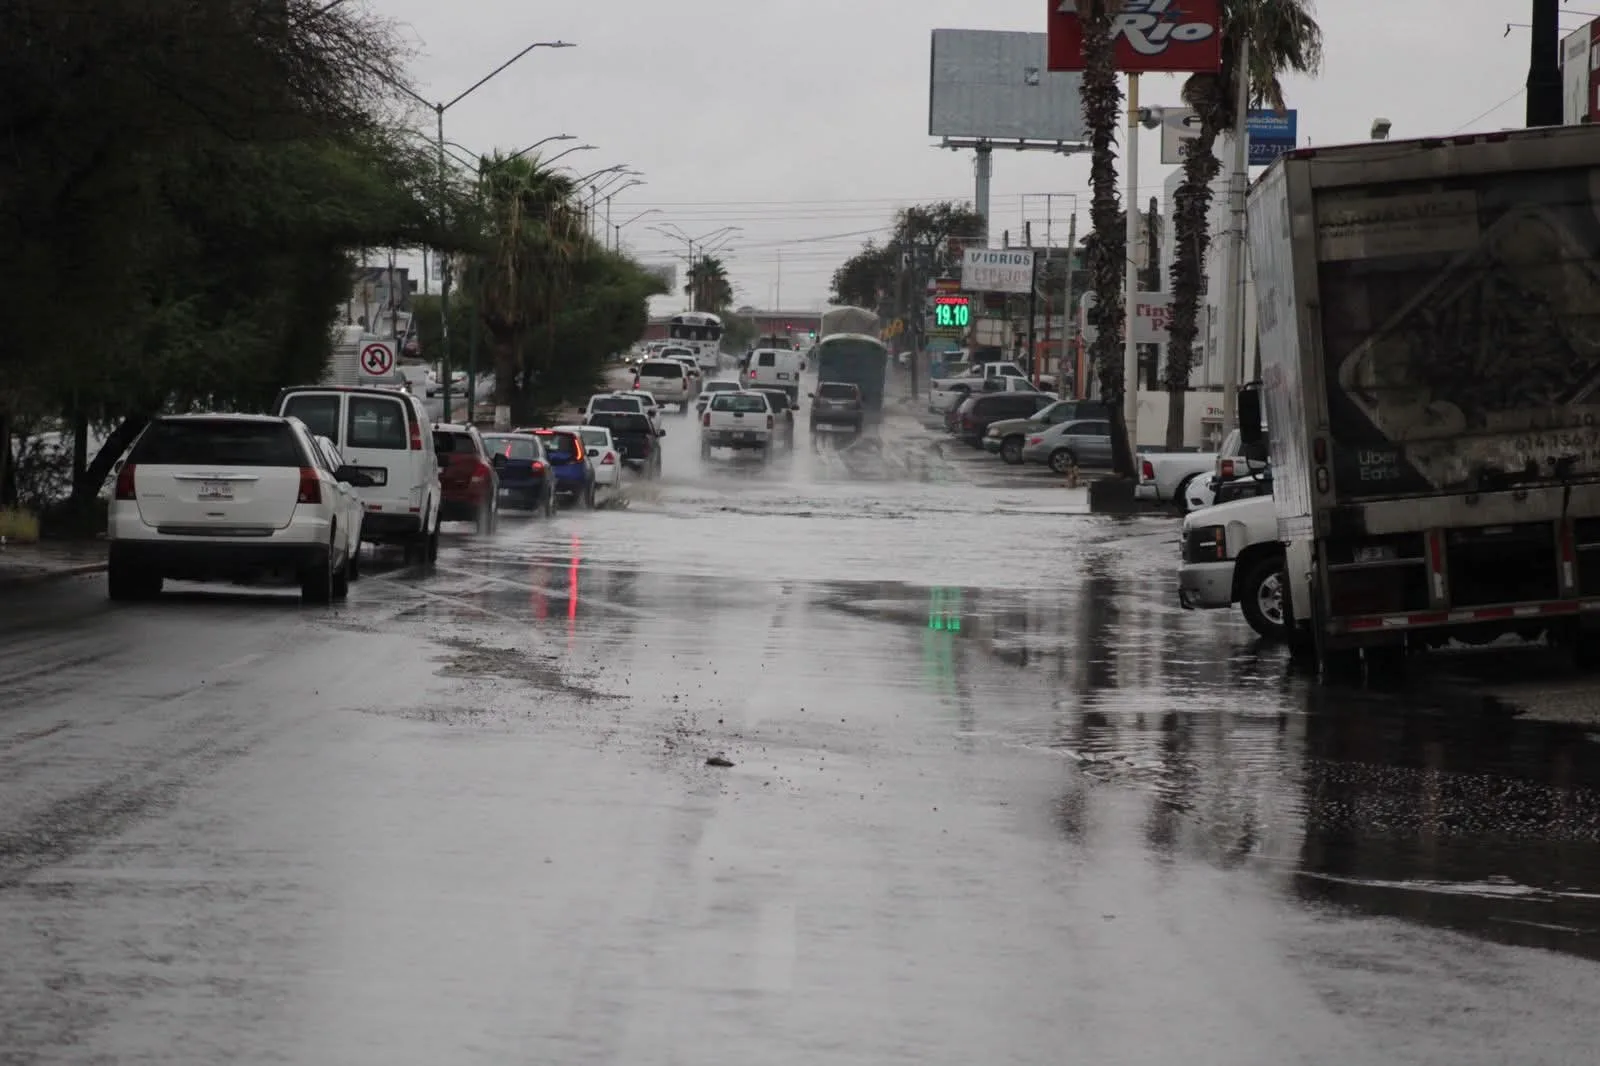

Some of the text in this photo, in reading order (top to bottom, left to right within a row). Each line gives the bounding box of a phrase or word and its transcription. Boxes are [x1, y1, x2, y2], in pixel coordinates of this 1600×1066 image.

[971, 252, 1030, 266] VIDRIOS
[936, 304, 968, 326] 19.10
[1359, 449, 1396, 465] Uber
